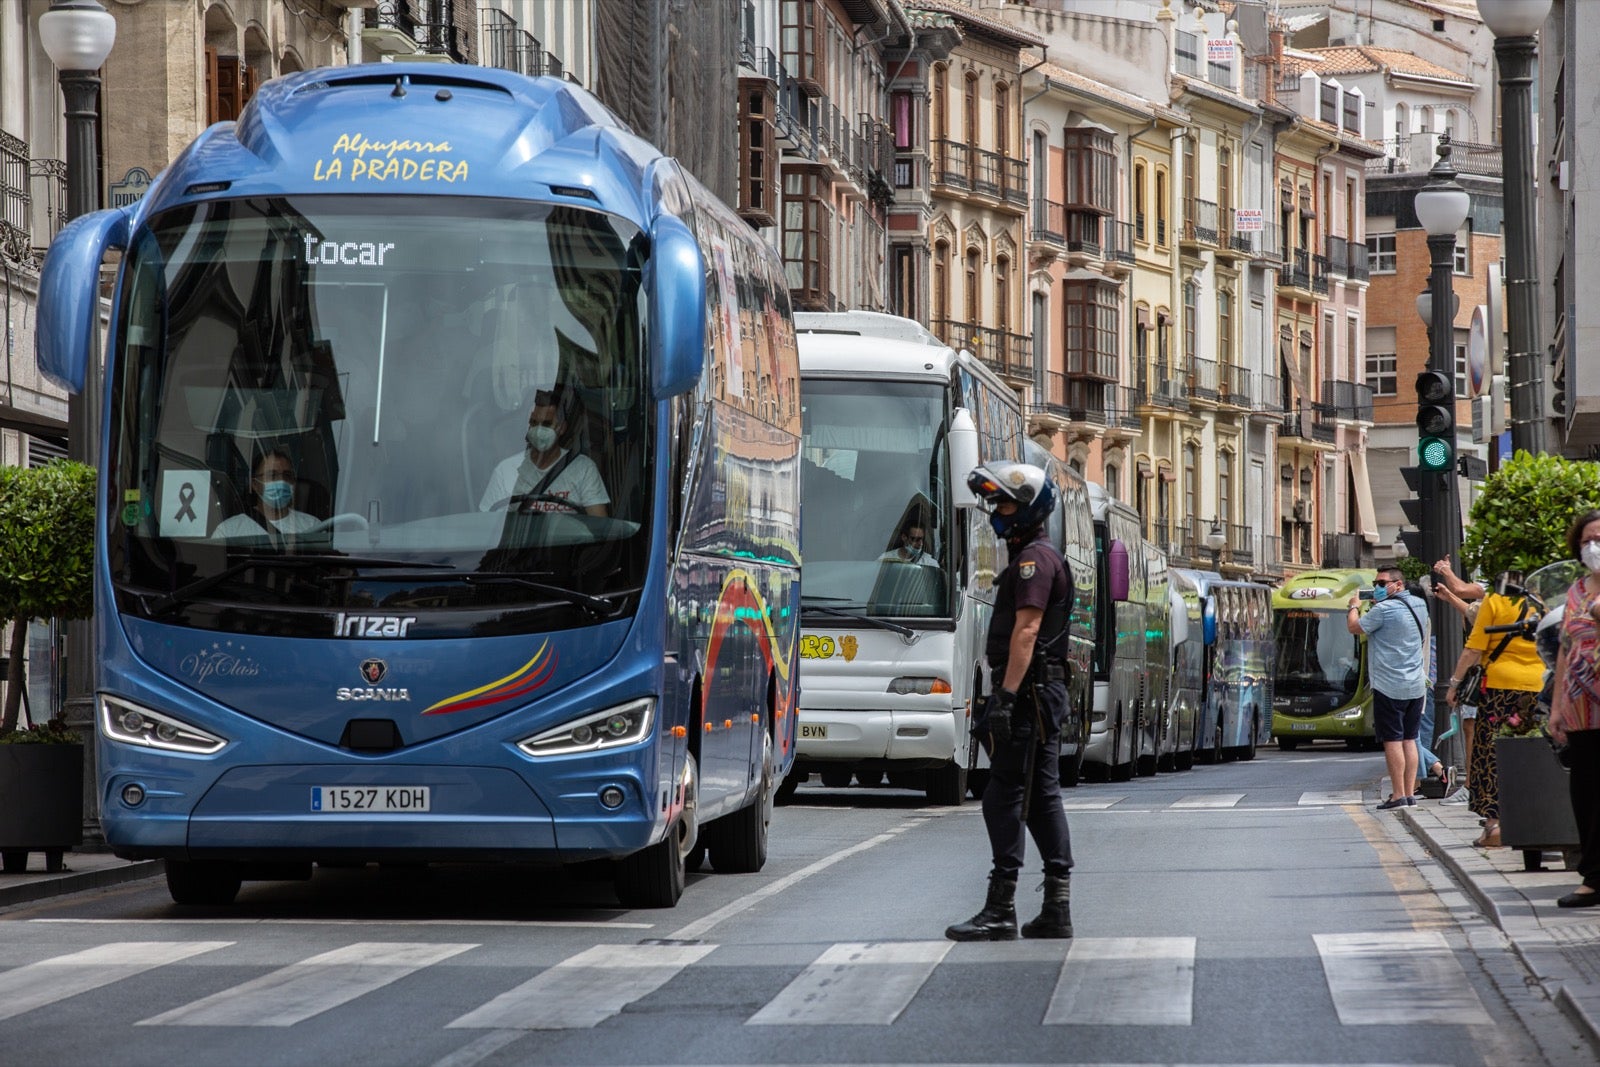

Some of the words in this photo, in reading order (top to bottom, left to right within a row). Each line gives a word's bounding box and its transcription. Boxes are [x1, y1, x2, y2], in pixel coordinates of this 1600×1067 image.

[332, 133, 453, 159] Alpujarra
[313, 158, 343, 181] LA
[351, 157, 469, 182] PRADERA
[304, 233, 395, 266] tocar
[1301, 587, 1317, 600] stg
[334, 612, 417, 637] Irizar
[800, 634, 836, 659] RO
[336, 687, 412, 701] SCANIA
[802, 725, 826, 737] BVN
[329, 790, 378, 809] 1527
[386, 789, 424, 809] KDH
